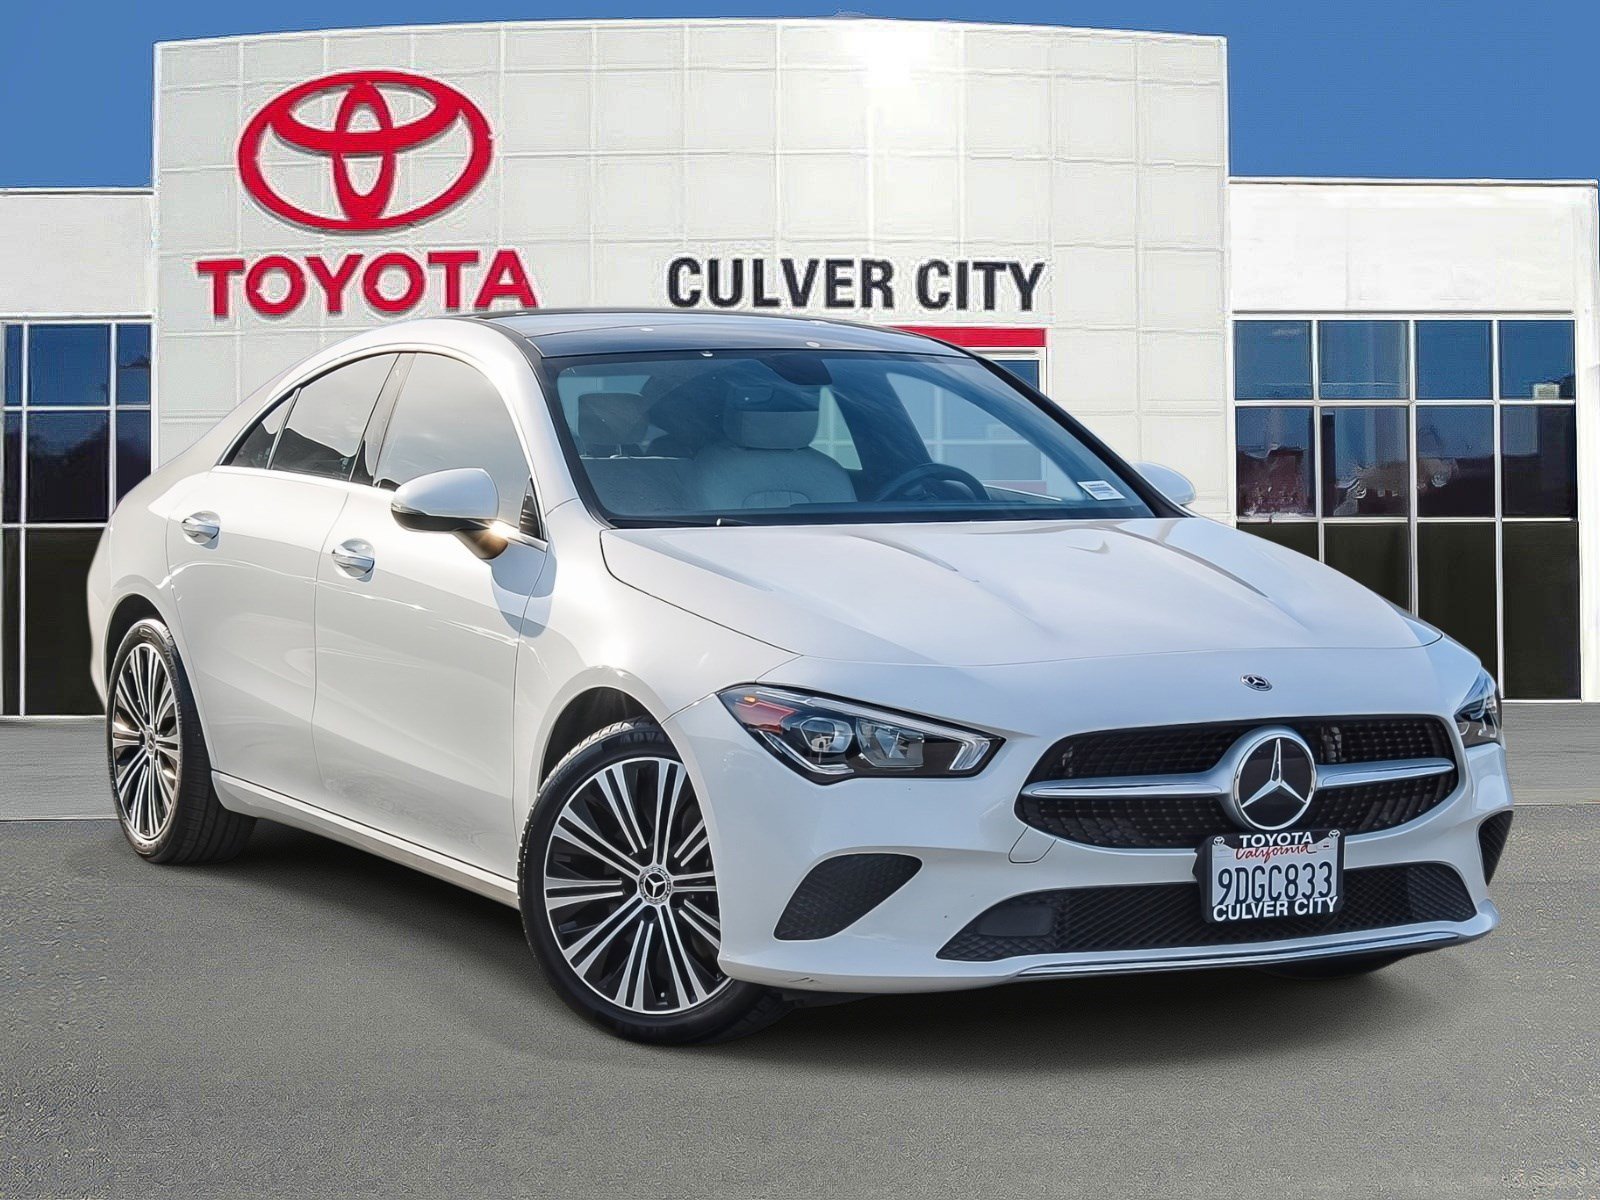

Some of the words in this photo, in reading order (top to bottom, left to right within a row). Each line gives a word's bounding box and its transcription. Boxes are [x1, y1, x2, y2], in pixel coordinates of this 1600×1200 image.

[197, 250, 536, 317] TOYOTA
[668, 257, 893, 309] CULVER
[917, 257, 1045, 311] CITY
[1236, 845, 1316, 863] California
[1239, 832, 1313, 847] TOYOTA
[1217, 861, 1332, 905] 9DGC833
[1213, 901, 1288, 921] CULVER
[1295, 896, 1338, 915] CITY
